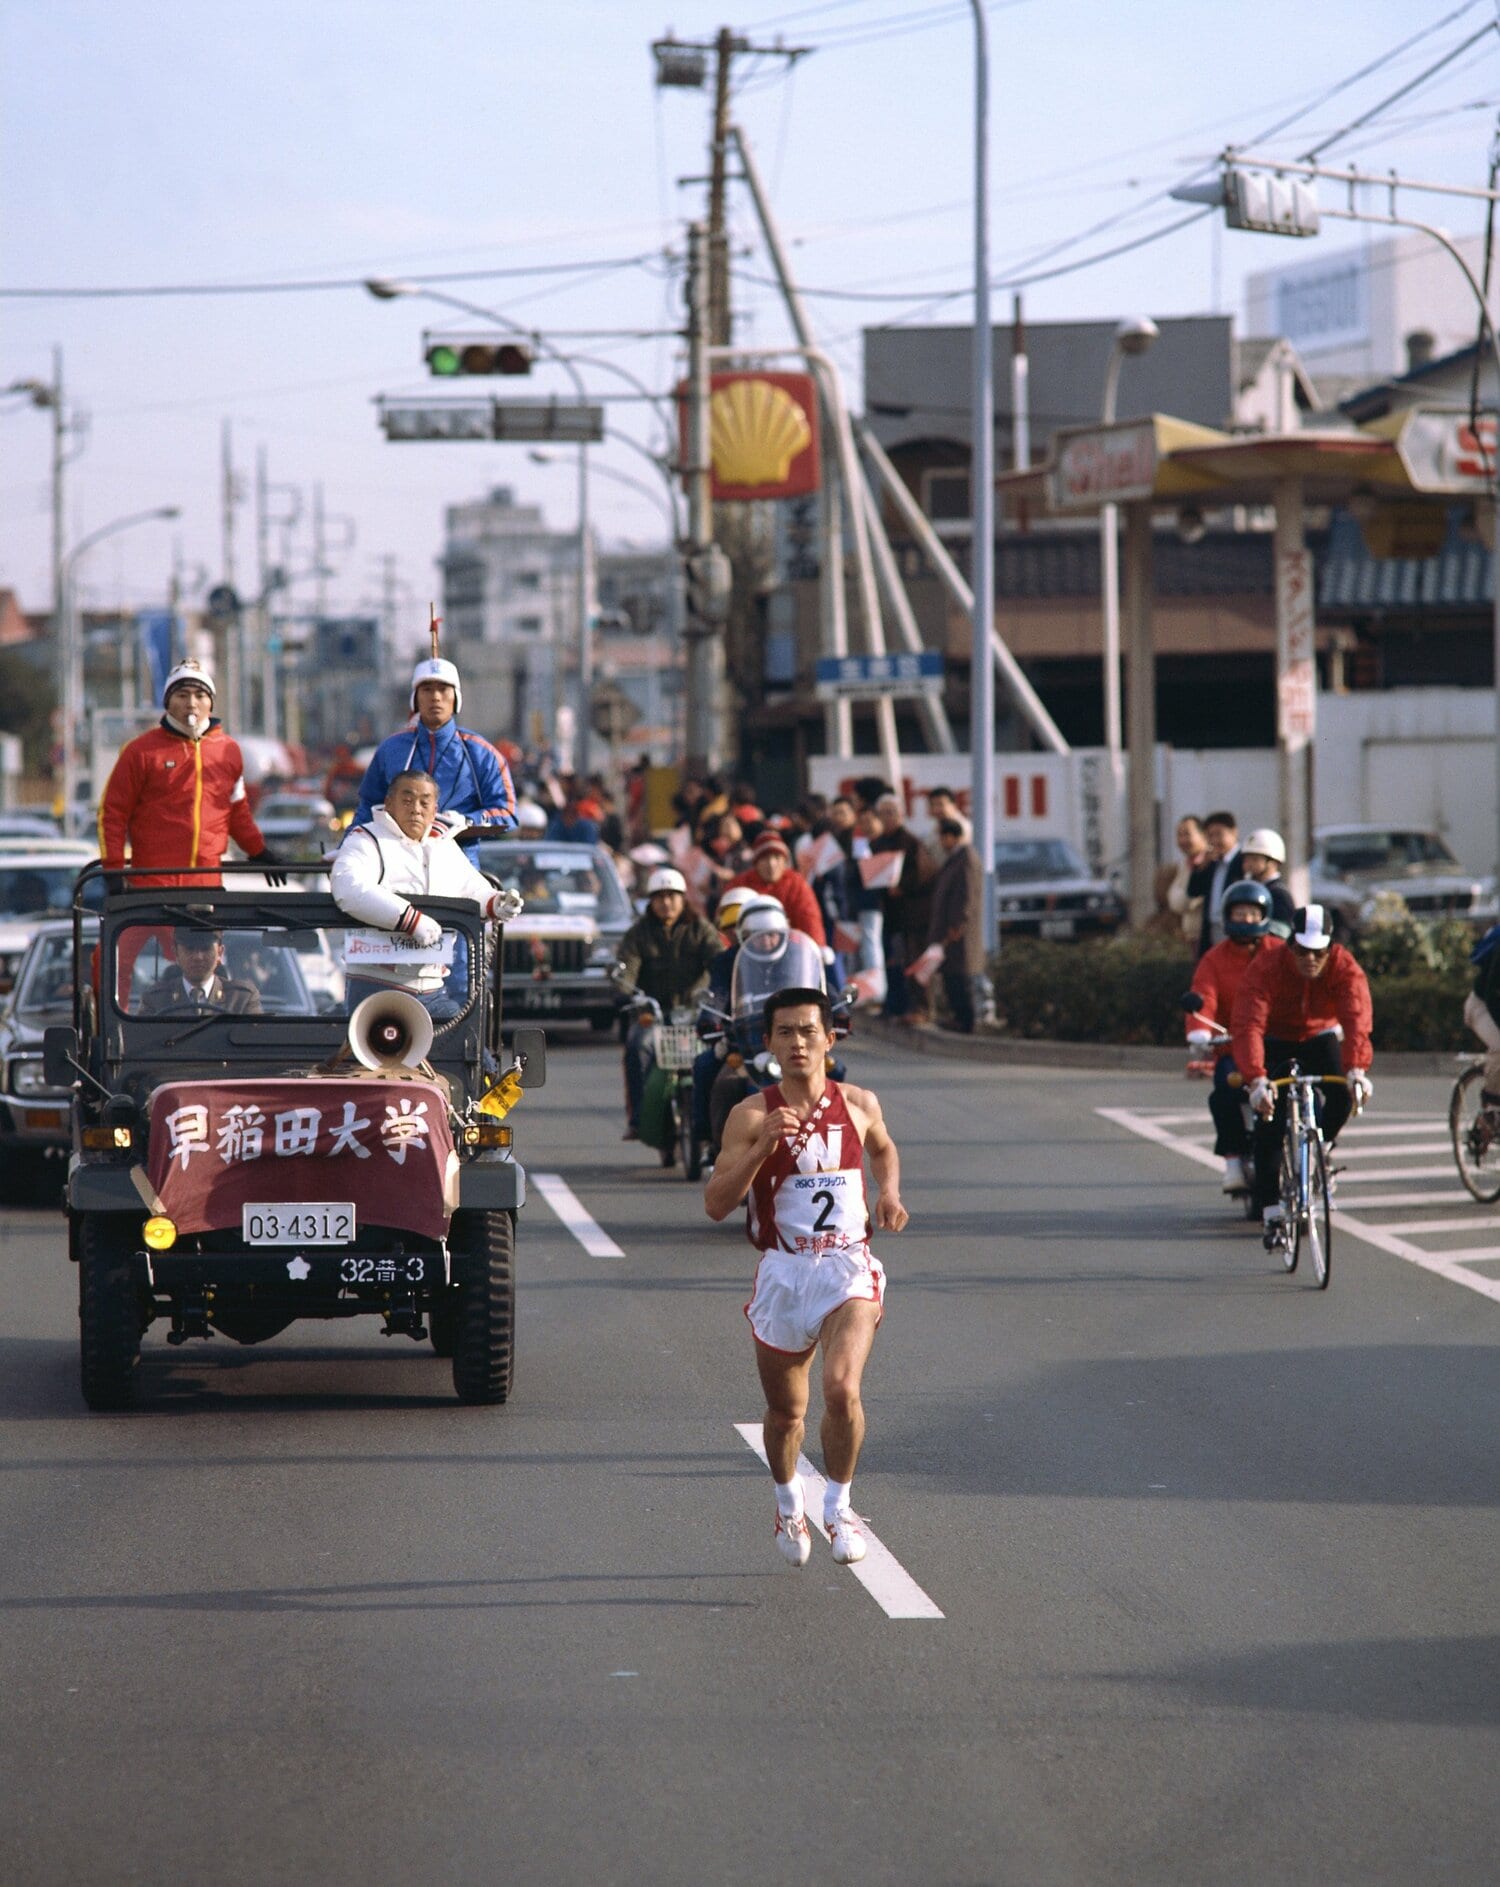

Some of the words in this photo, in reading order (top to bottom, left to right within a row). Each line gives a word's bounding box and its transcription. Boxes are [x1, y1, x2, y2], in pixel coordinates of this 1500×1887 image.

[165, 1099, 429, 1171] 早稲田大学
[250, 1215, 349, 1239] 03-4312
[811, 1190, 836, 1232] 2
